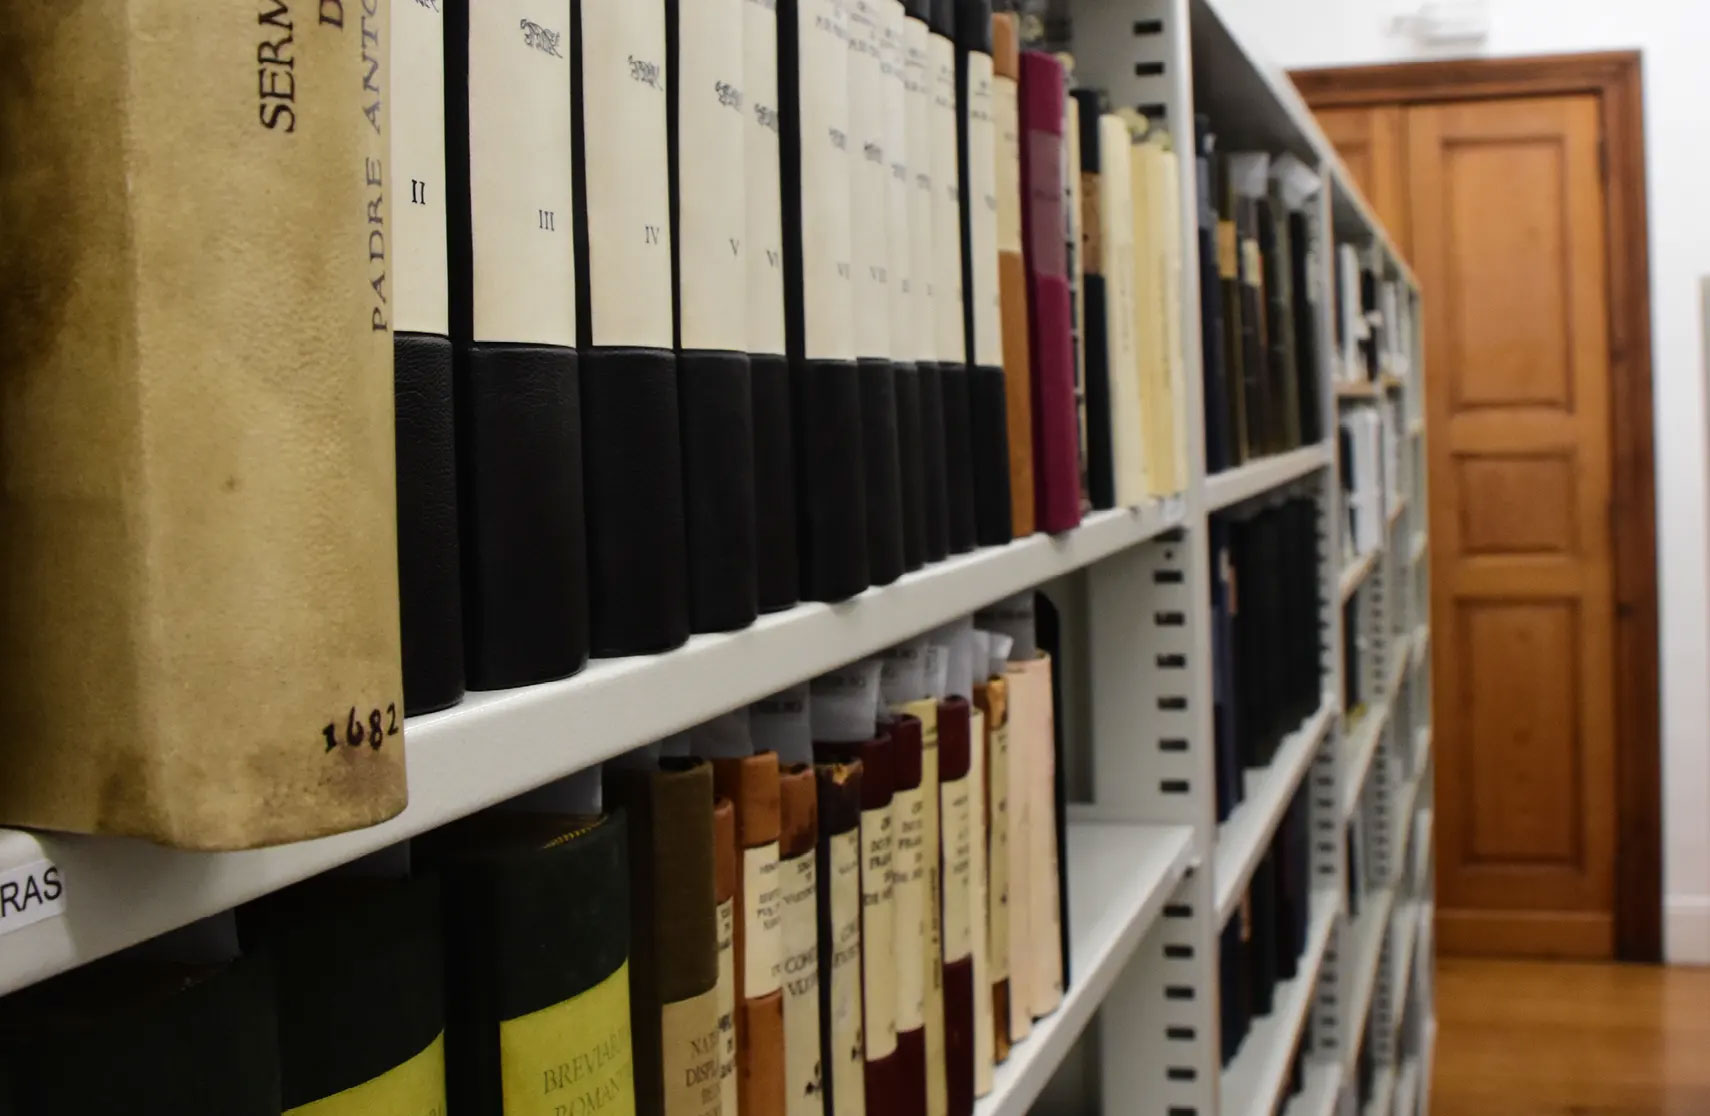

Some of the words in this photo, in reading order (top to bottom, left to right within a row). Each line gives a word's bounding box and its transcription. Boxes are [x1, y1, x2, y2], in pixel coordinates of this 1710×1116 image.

[411, 179, 426, 205] II
[538, 209, 555, 232] III
[644, 225, 660, 245] IV
[365, 157, 389, 333] PADRE
[321, 702, 399, 753] 1682
[0, 866, 62, 918] RAS
